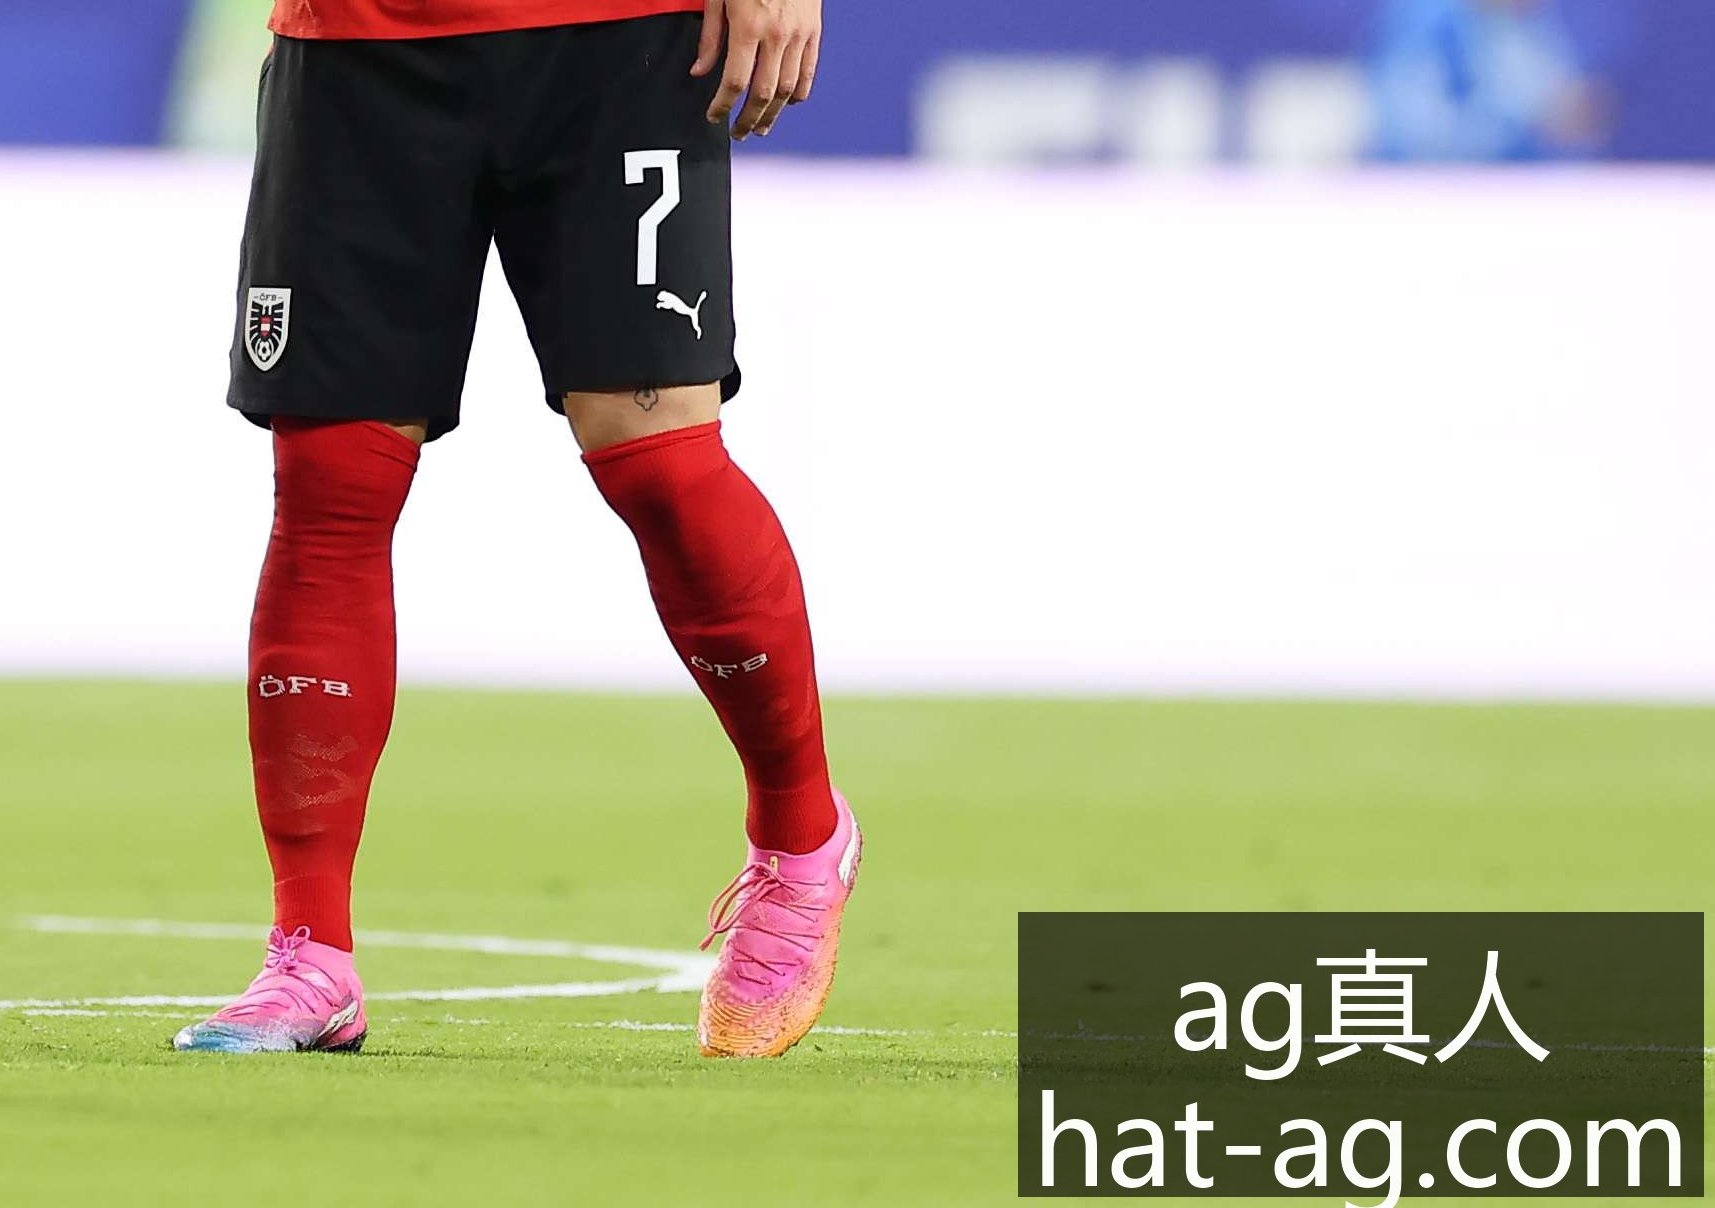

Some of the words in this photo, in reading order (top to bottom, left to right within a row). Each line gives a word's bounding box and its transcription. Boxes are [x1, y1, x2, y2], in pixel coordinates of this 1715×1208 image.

[624, 149, 681, 285] 7
[690, 652, 768, 680] ÖFB
[259, 674, 351, 698] ÖFB
